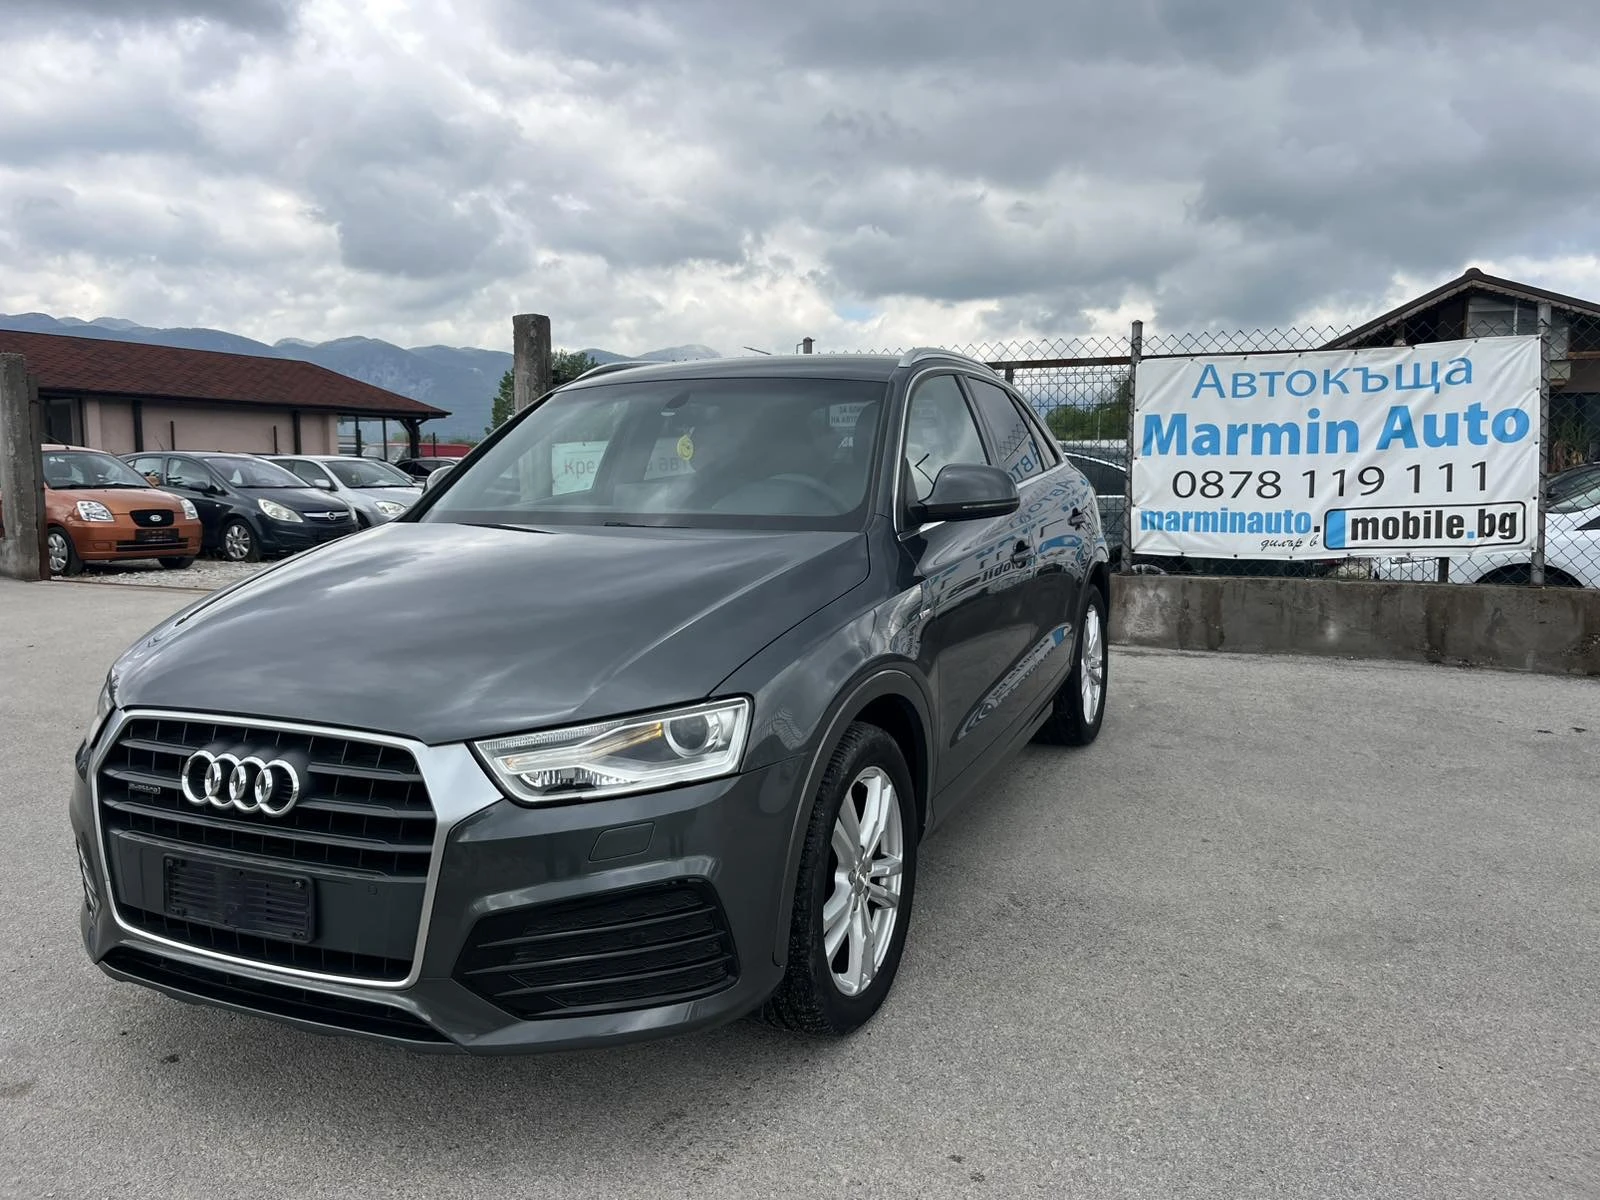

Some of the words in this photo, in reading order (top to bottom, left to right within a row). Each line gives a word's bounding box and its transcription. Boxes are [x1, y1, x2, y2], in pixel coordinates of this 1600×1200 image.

[1191, 356, 1473, 399] Автокъща
[1141, 408, 1360, 457] Marmin
[1376, 402, 1531, 451] Auto
[1172, 470, 1283, 499] 0878
[1302, 466, 1385, 499] 119
[1406, 461, 1488, 494] 111
[1350, 508, 1518, 541] mobile.bg
